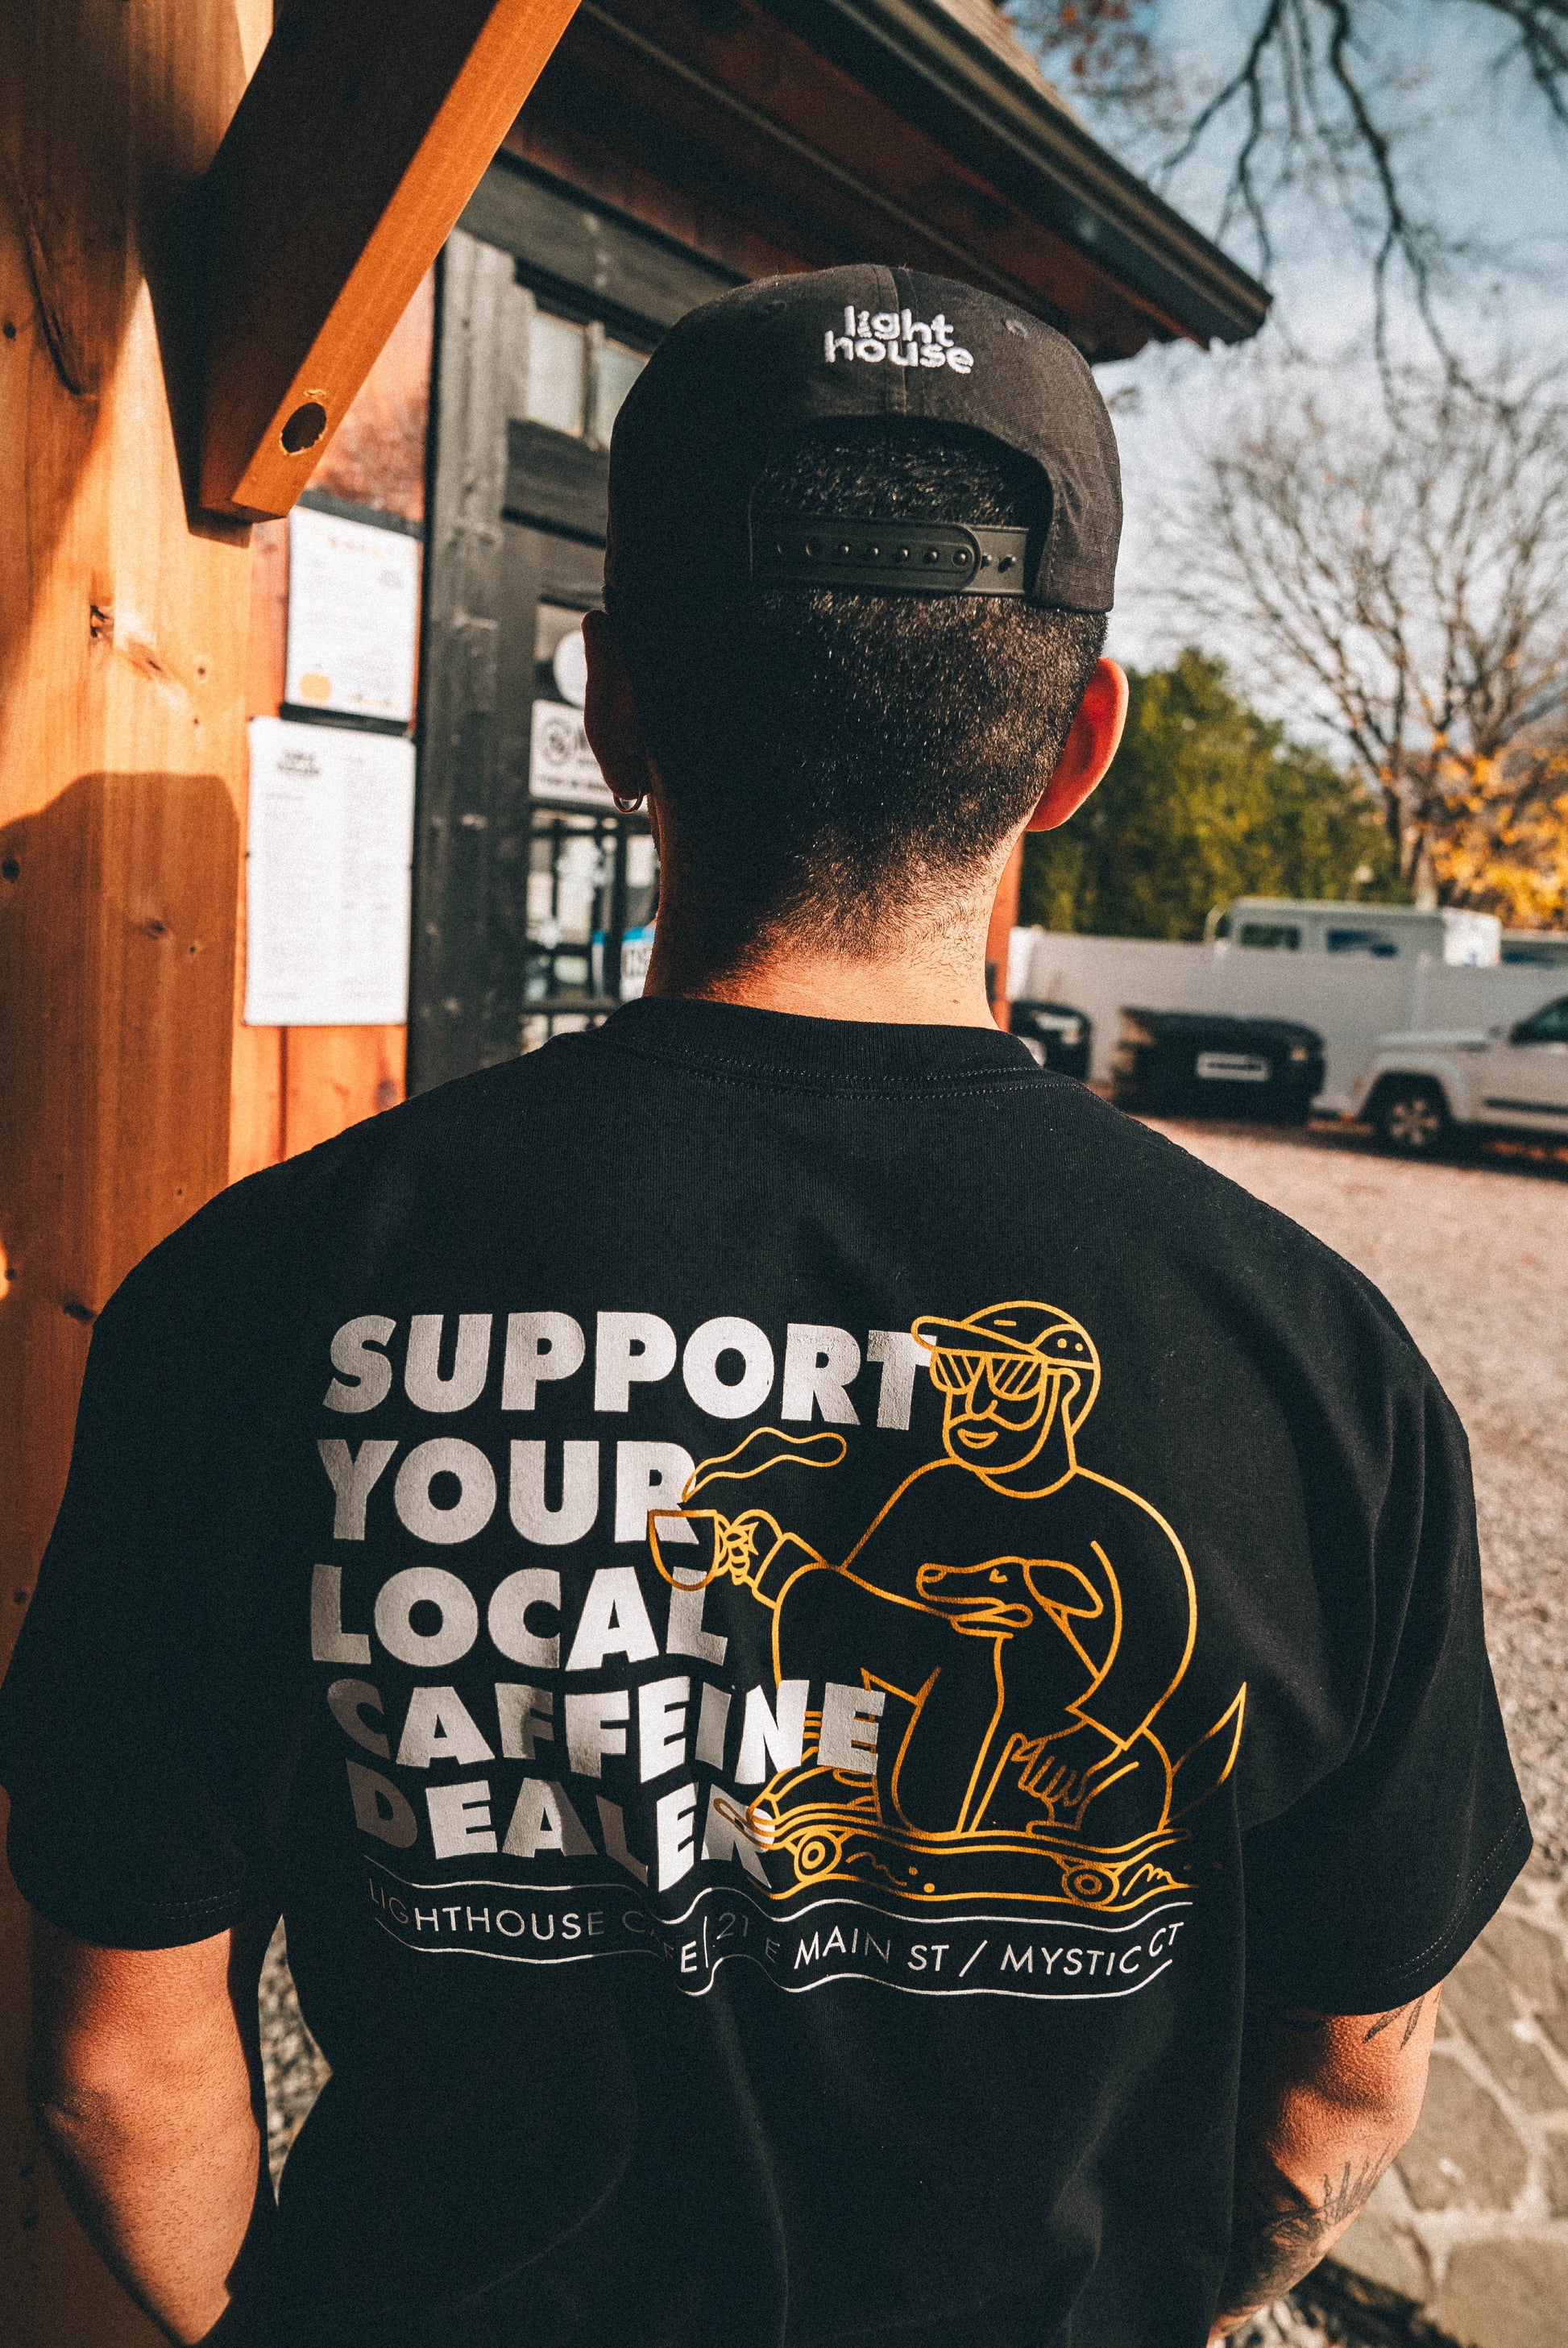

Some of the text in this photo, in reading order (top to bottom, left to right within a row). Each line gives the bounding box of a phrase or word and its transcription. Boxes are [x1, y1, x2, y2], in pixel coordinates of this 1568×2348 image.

[824, 330, 974, 374] house
[844, 305, 954, 347] light
[322, 1310, 938, 1431] SUPPORT
[317, 1437, 699, 1545] YOUR
[310, 1563, 728, 1671] LOCAL
[326, 1675, 886, 1784] CAFFEINE
[345, 1757, 777, 1893] DEALER
[369, 1877, 604, 1941] LIGHTHOUSE
[794, 1924, 891, 1970] MAIN
[906, 1944, 950, 1973] ST
[958, 1939, 988, 1978] /
[999, 1944, 1143, 1976] MYSTIC
[1148, 1921, 1185, 1958] CT
